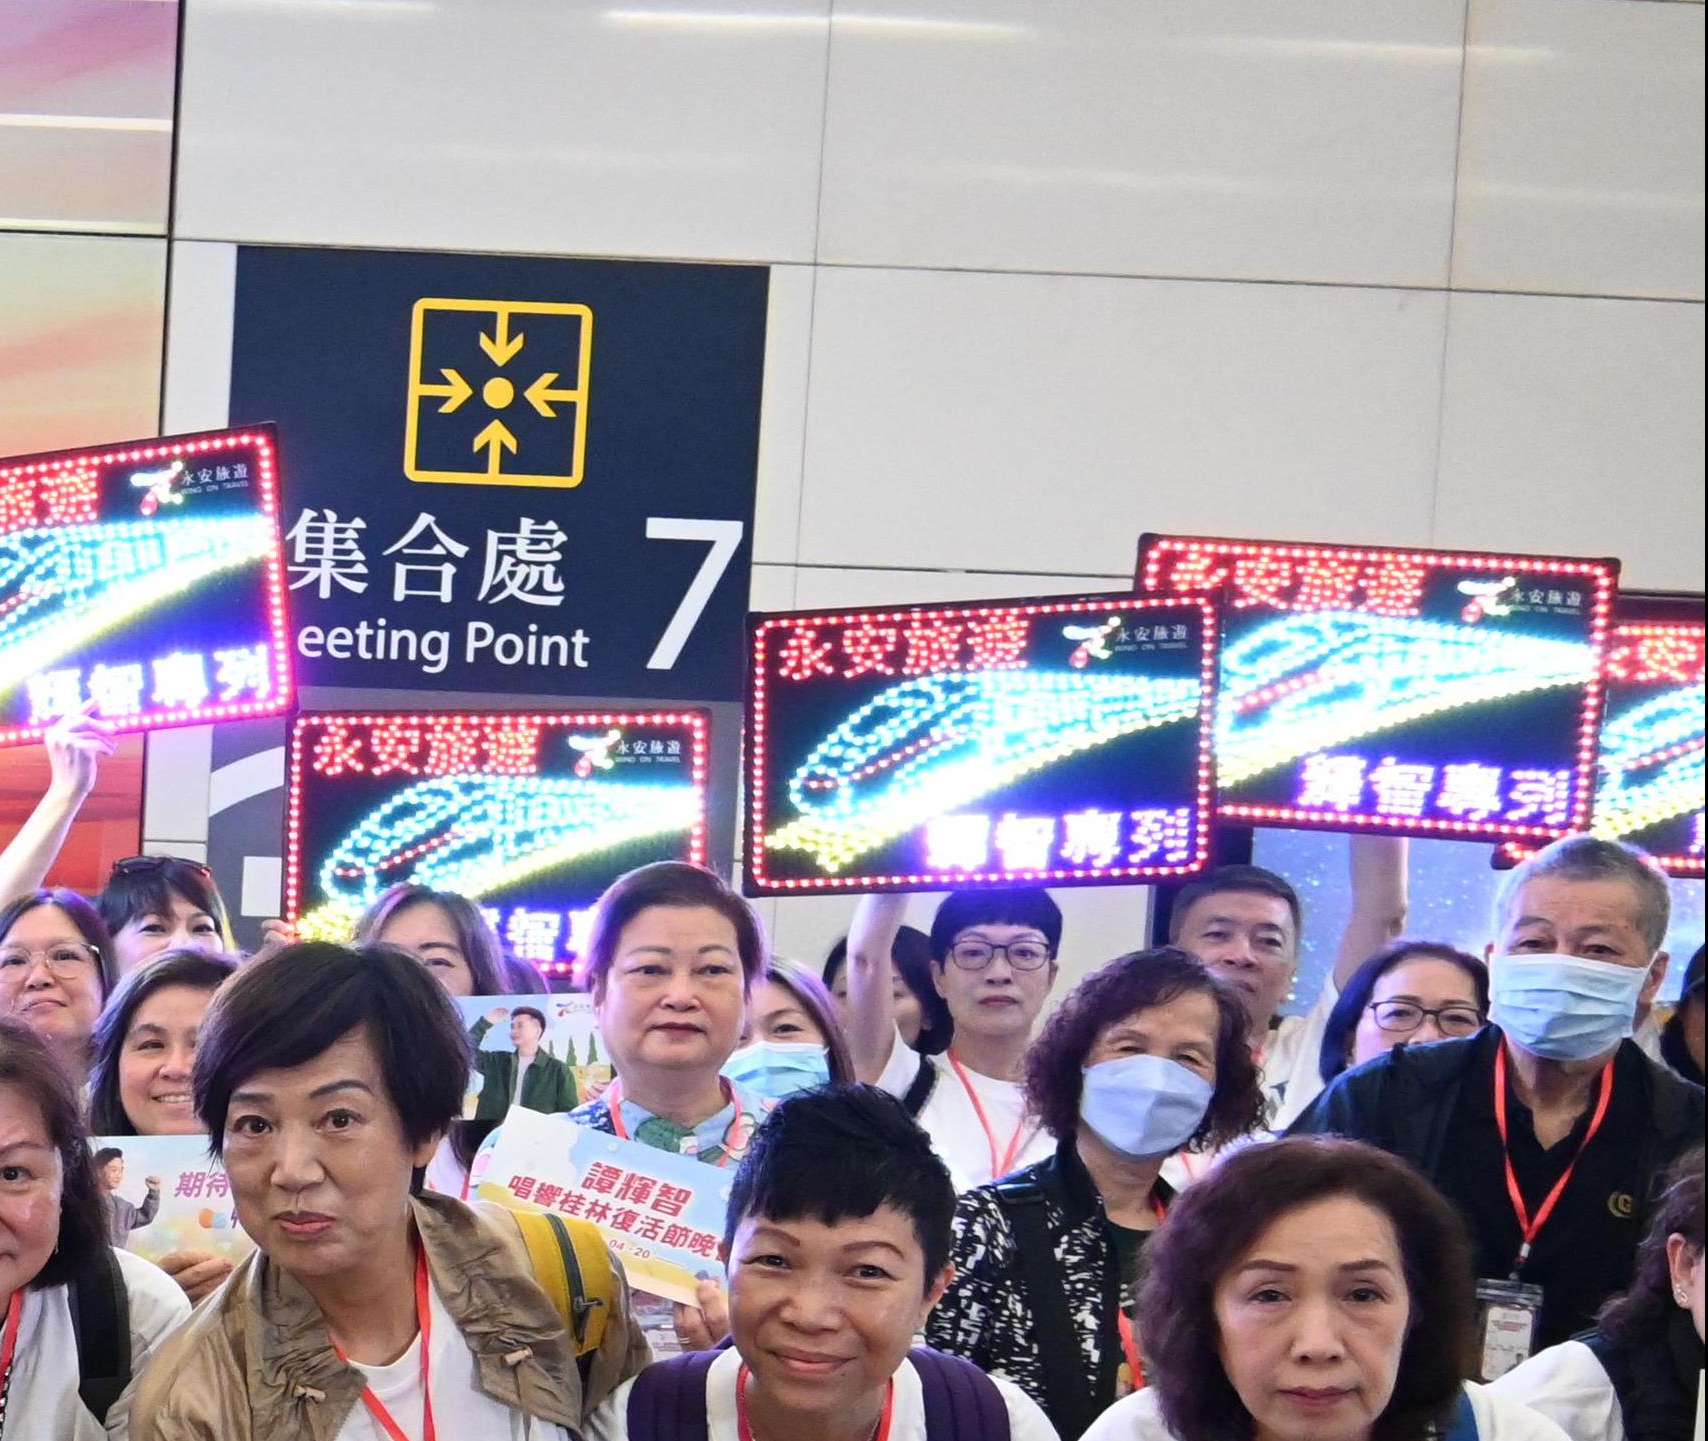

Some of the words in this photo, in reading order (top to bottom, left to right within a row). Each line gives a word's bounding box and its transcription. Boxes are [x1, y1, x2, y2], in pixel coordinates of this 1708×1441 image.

[284, 507, 569, 607] 集合處
[645, 516, 744, 671] 7
[297, 617, 450, 672] eeting
[465, 622, 590, 669] Point
[777, 617, 1031, 680] 永安旅遊
[311, 725, 540, 777] 永安旅遊
[1301, 753, 1571, 826] 輝智專列
[173, 1171, 230, 1198] 期待
[580, 1161, 693, 1218] 譚輝智
[608, 1239, 625, 1252] 04
[634, 1247, 651, 1260] 20
